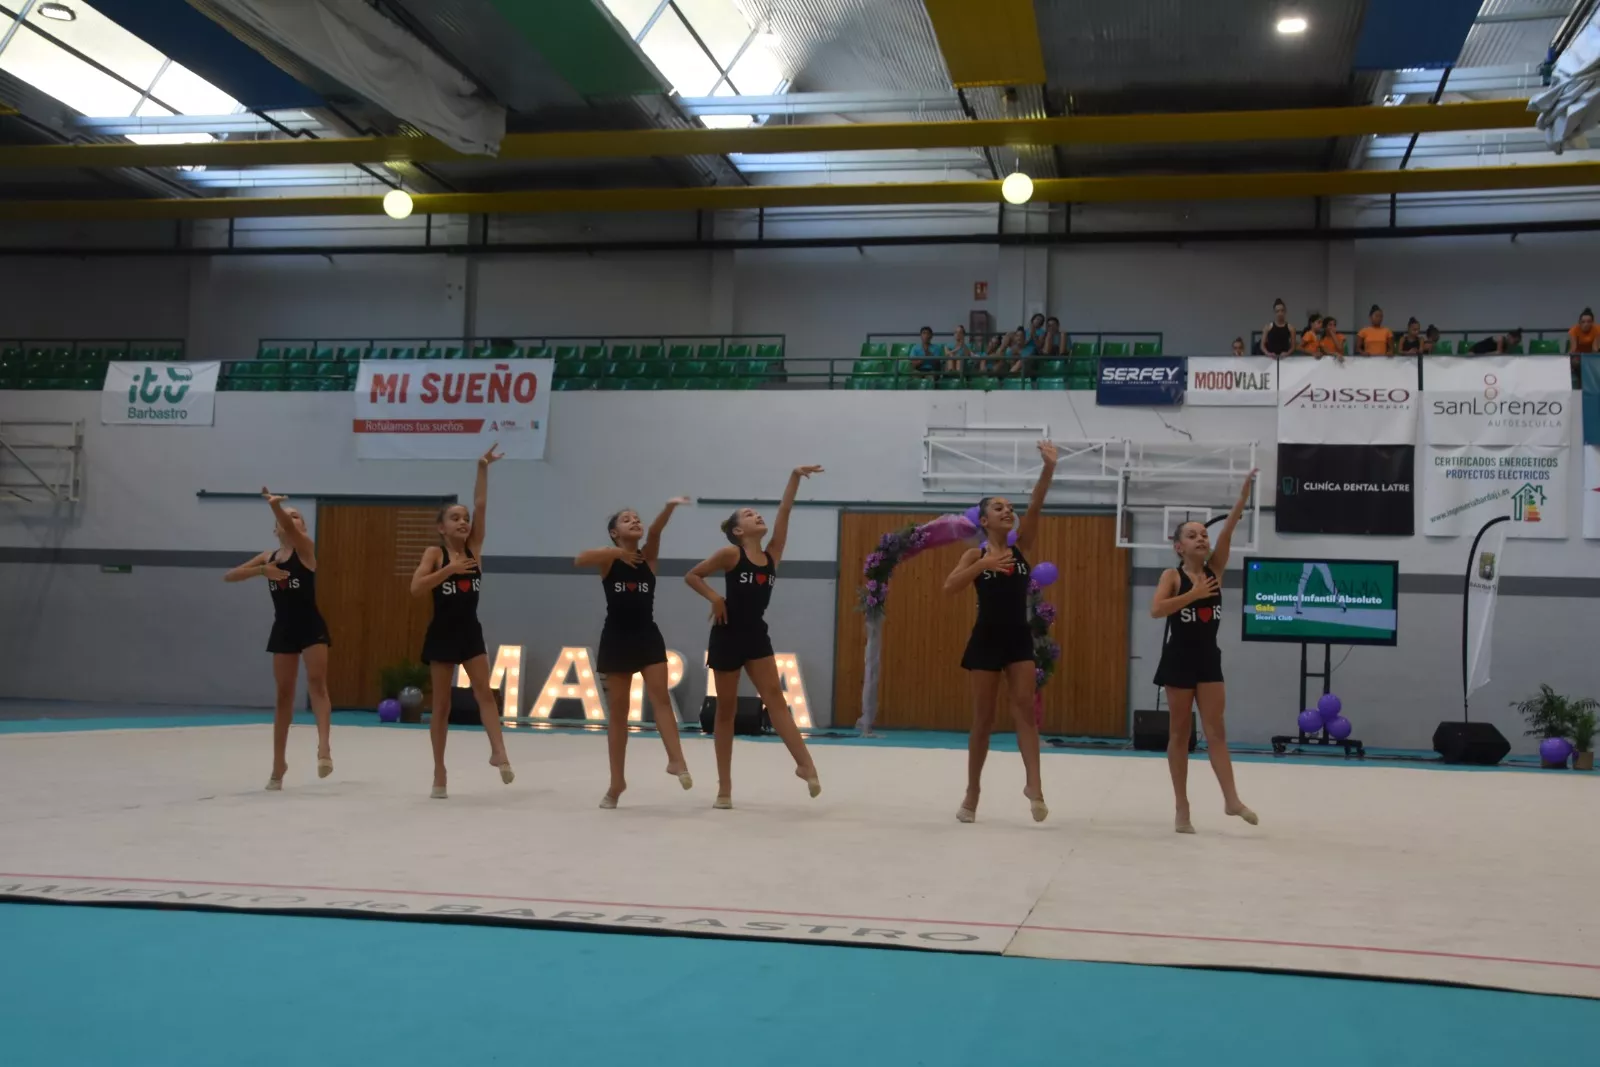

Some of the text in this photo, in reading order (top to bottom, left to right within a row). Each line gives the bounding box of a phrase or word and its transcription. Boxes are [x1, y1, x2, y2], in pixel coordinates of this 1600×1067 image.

[1102, 367, 1179, 381] SERFEY
[370, 363, 537, 404] MI SUEÑO
[1284, 384, 1410, 407] ADISSEO
[128, 407, 188, 420] Barbastro
[366, 420, 464, 432] Rotulamos tus sueños
[1435, 456, 1496, 467] CERTIFICADOS
[1446, 469, 1495, 480] PROYECTOS
[1343, 483, 1379, 492] DENTAL
[1382, 484, 1410, 493] LATRE
[1255, 592, 1382, 605] Conjunto Infantil Absoluto
[426, 903, 980, 942] BARBASTRO
